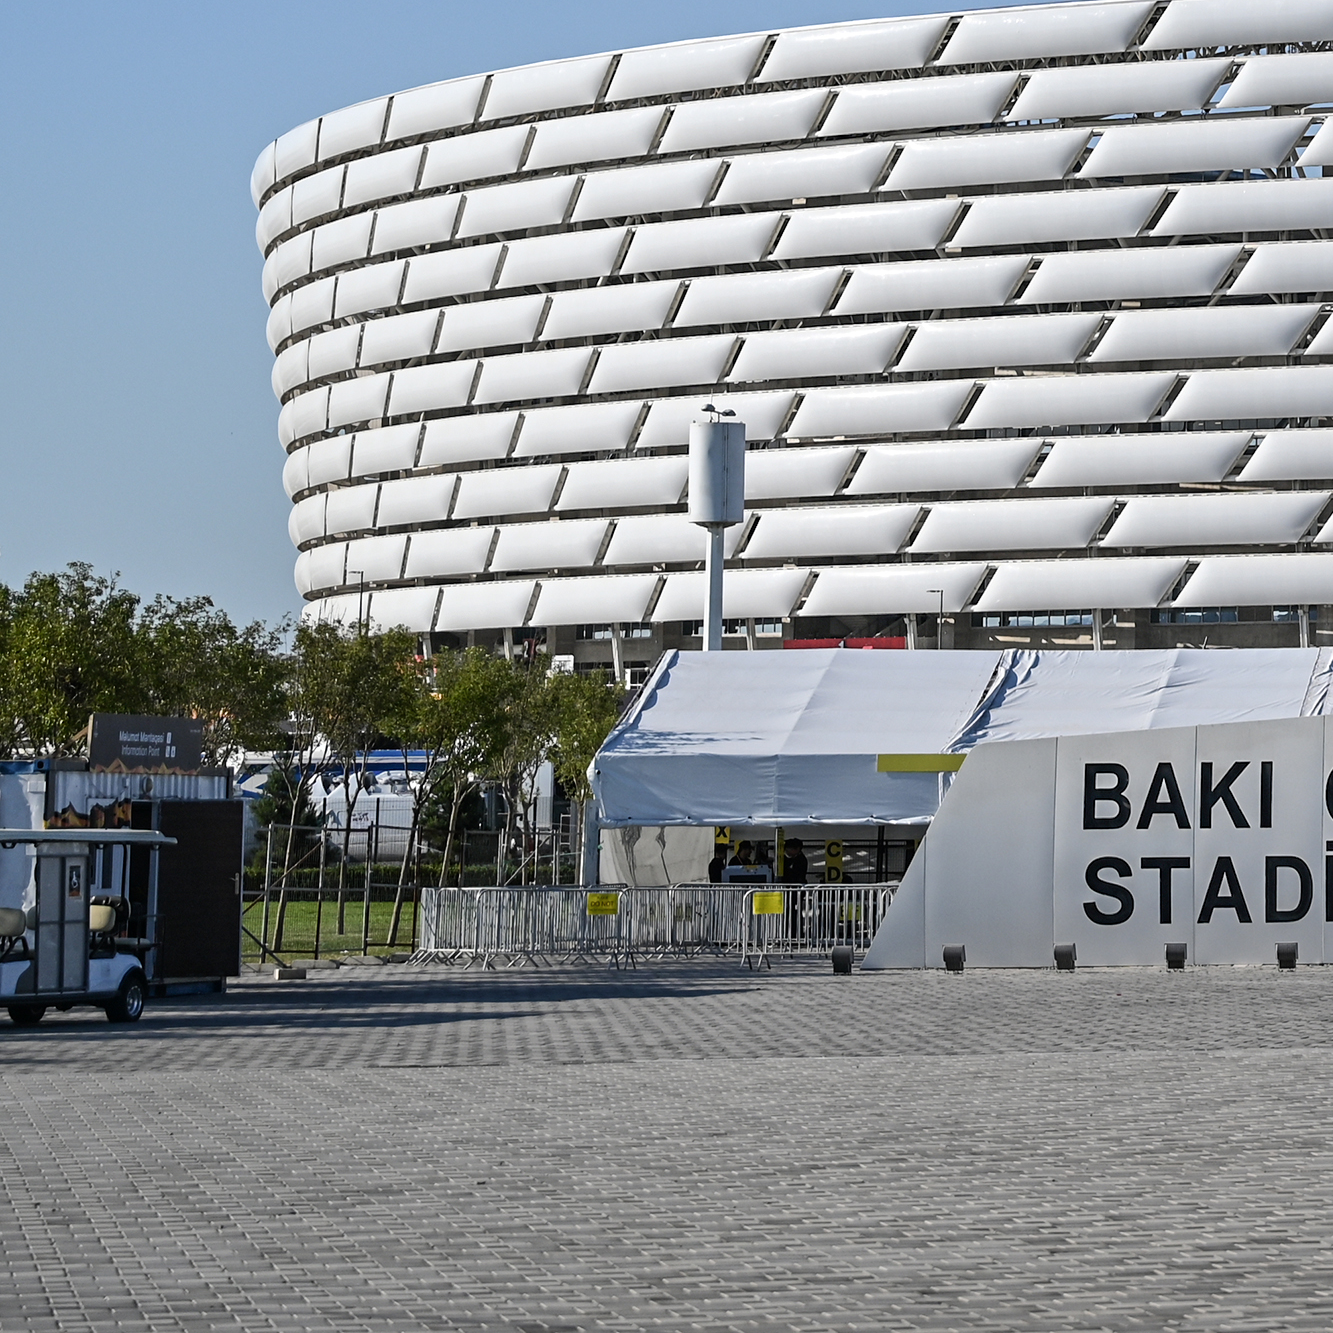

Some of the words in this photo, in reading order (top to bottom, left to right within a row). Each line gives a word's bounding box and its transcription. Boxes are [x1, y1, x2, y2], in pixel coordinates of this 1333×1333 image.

[121, 744, 147, 756] Information
[148, 745, 160, 756] Point
[1083, 761, 1274, 830] BAKI
[716, 826, 728, 838] X
[827, 842, 842, 858] C
[828, 867, 841, 881] D
